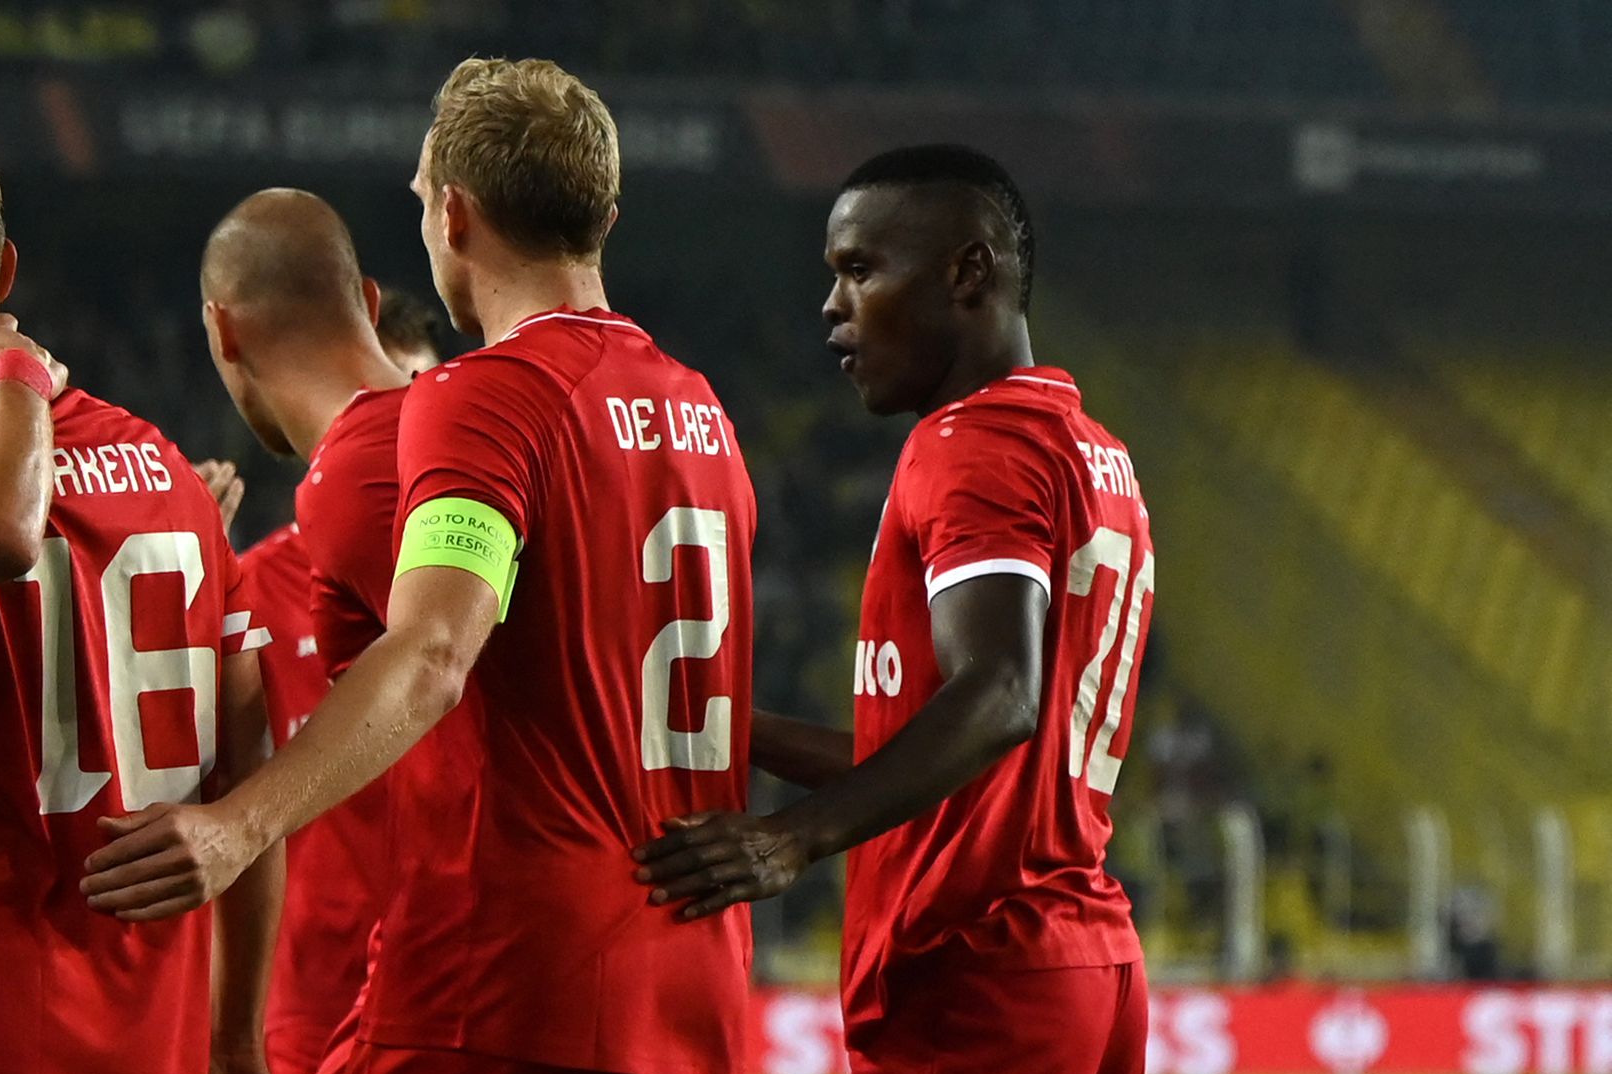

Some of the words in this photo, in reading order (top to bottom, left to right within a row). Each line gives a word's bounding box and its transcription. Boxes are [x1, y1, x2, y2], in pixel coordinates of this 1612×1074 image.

[605, 396, 663, 452] DE
[664, 397, 732, 457] LAET
[1075, 440, 1142, 507] SAM
[419, 513, 441, 529] NO
[444, 513, 465, 525] TO
[640, 506, 732, 772] 2
[13, 531, 217, 816] 16
